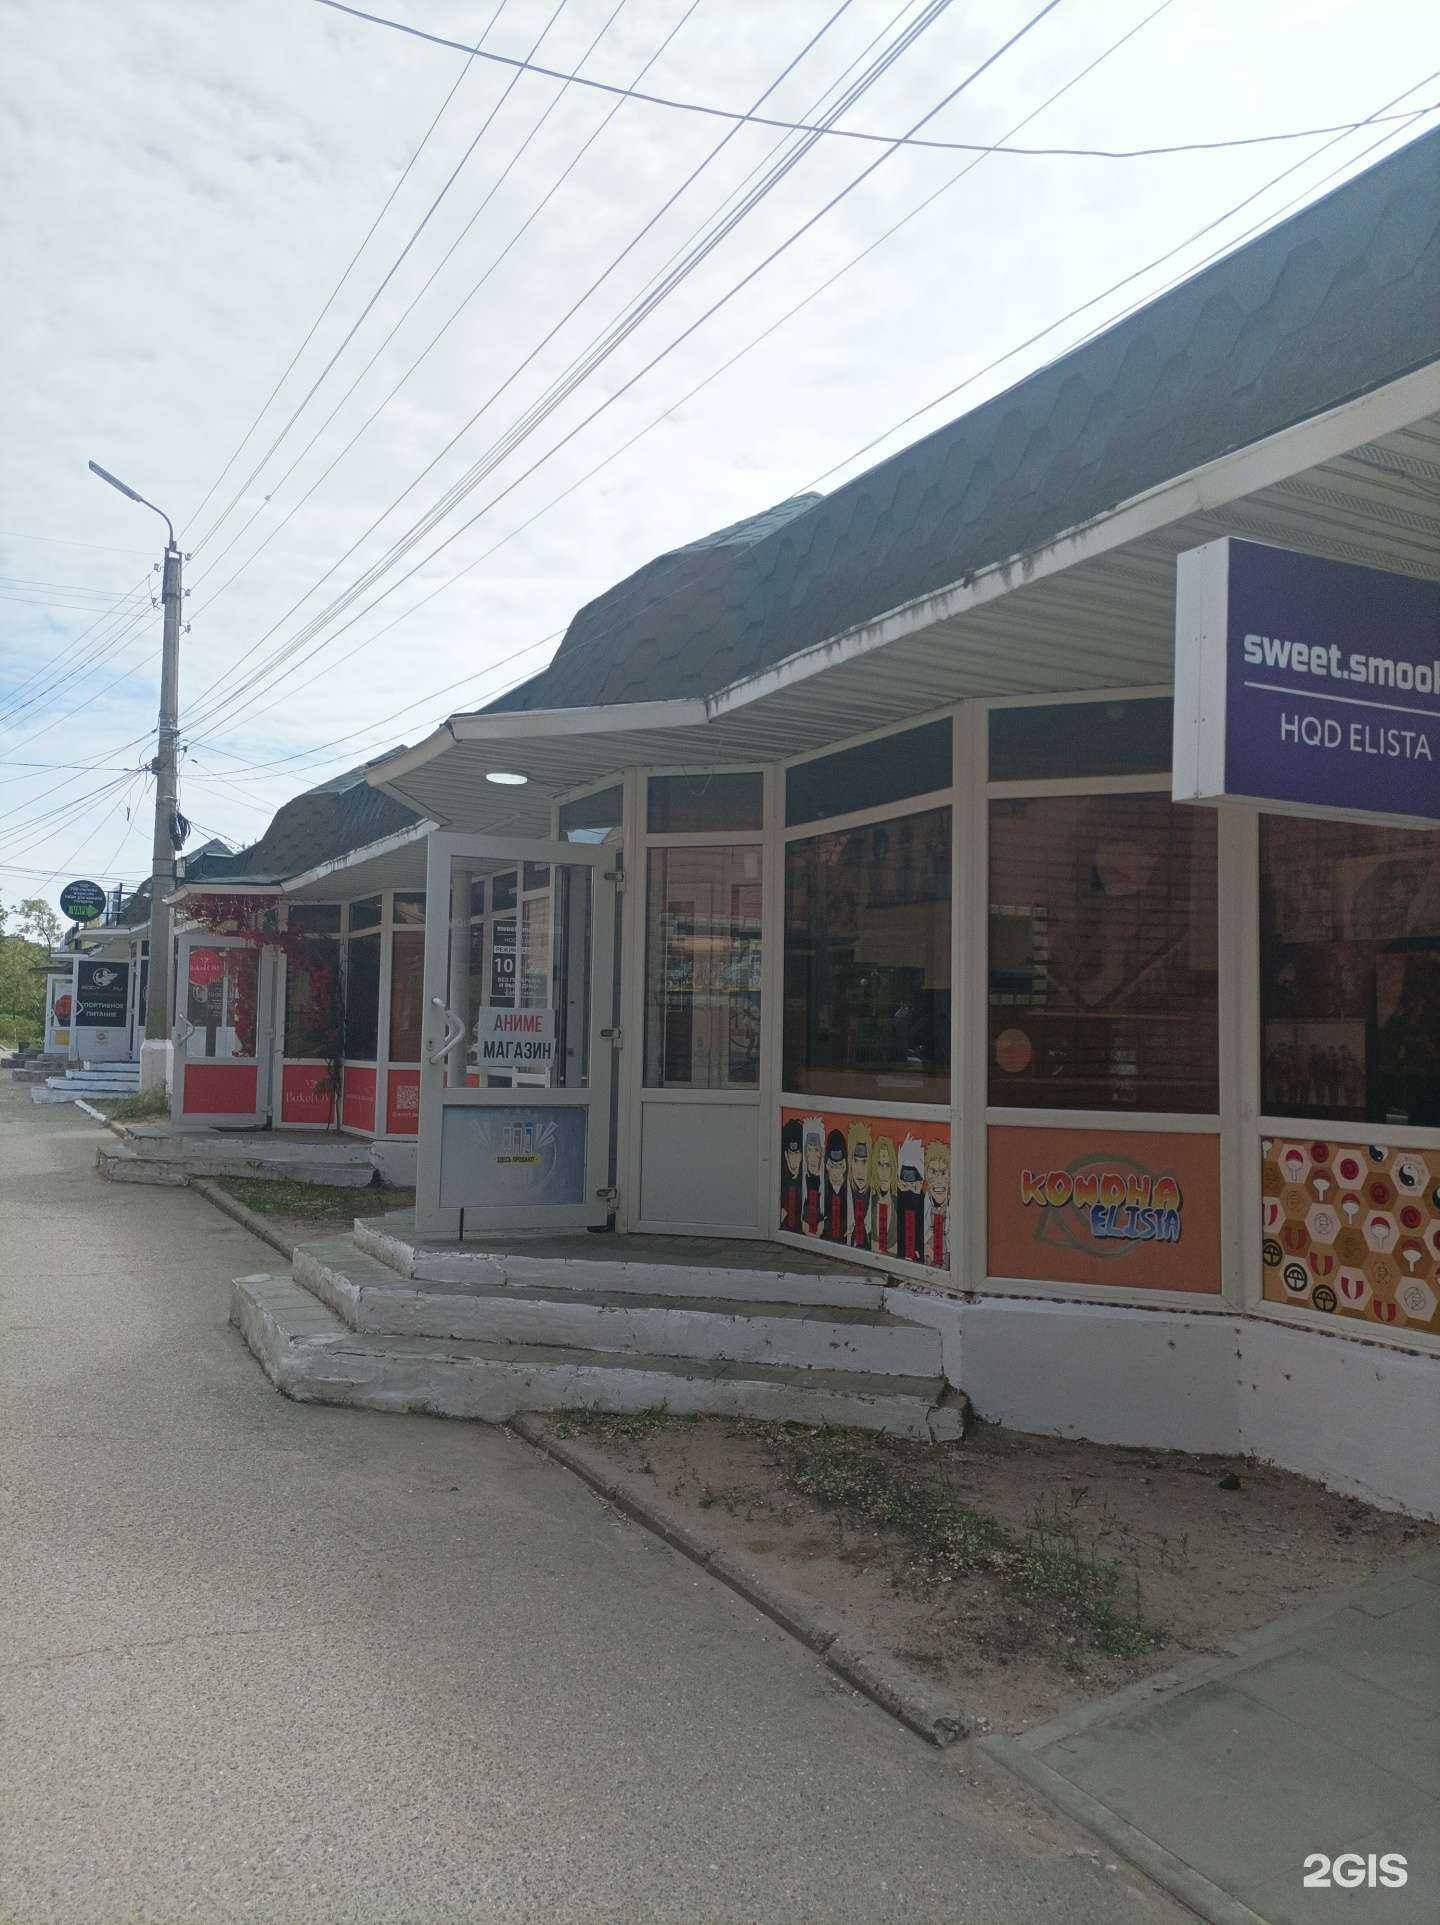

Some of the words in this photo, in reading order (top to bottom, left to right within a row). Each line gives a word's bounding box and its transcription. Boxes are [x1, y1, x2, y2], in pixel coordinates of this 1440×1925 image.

[1281, 712, 1342, 748] HQD
[1350, 723, 1433, 762] ELISTA
[494, 958, 514, 973] 10
[494, 1014, 543, 1033] АНИМЕ
[483, 1040, 552, 1060] МАГАЗИН
[1020, 1168, 1184, 1213] KONOHA
[1089, 1204, 1182, 1243] ELISTA
